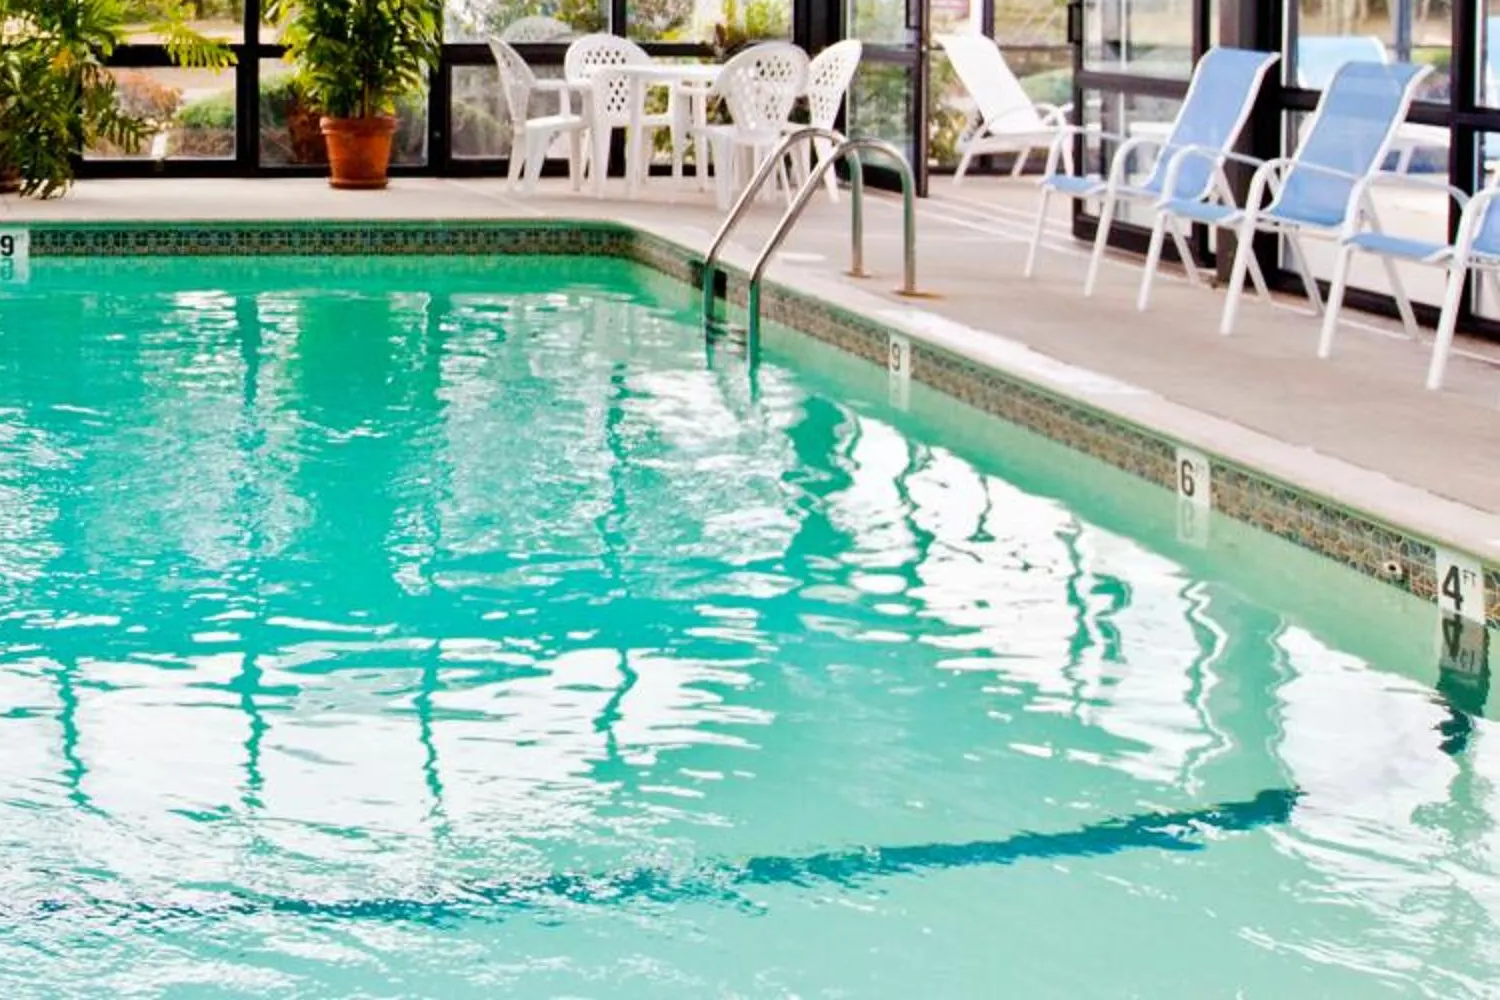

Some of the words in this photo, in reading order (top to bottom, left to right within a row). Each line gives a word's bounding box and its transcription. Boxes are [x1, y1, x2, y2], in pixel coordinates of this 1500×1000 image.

[0, 235, 14, 256] 9
[891, 343, 901, 371] 9
[1181, 460, 1195, 496] 6
[1442, 565, 1463, 611] 4
